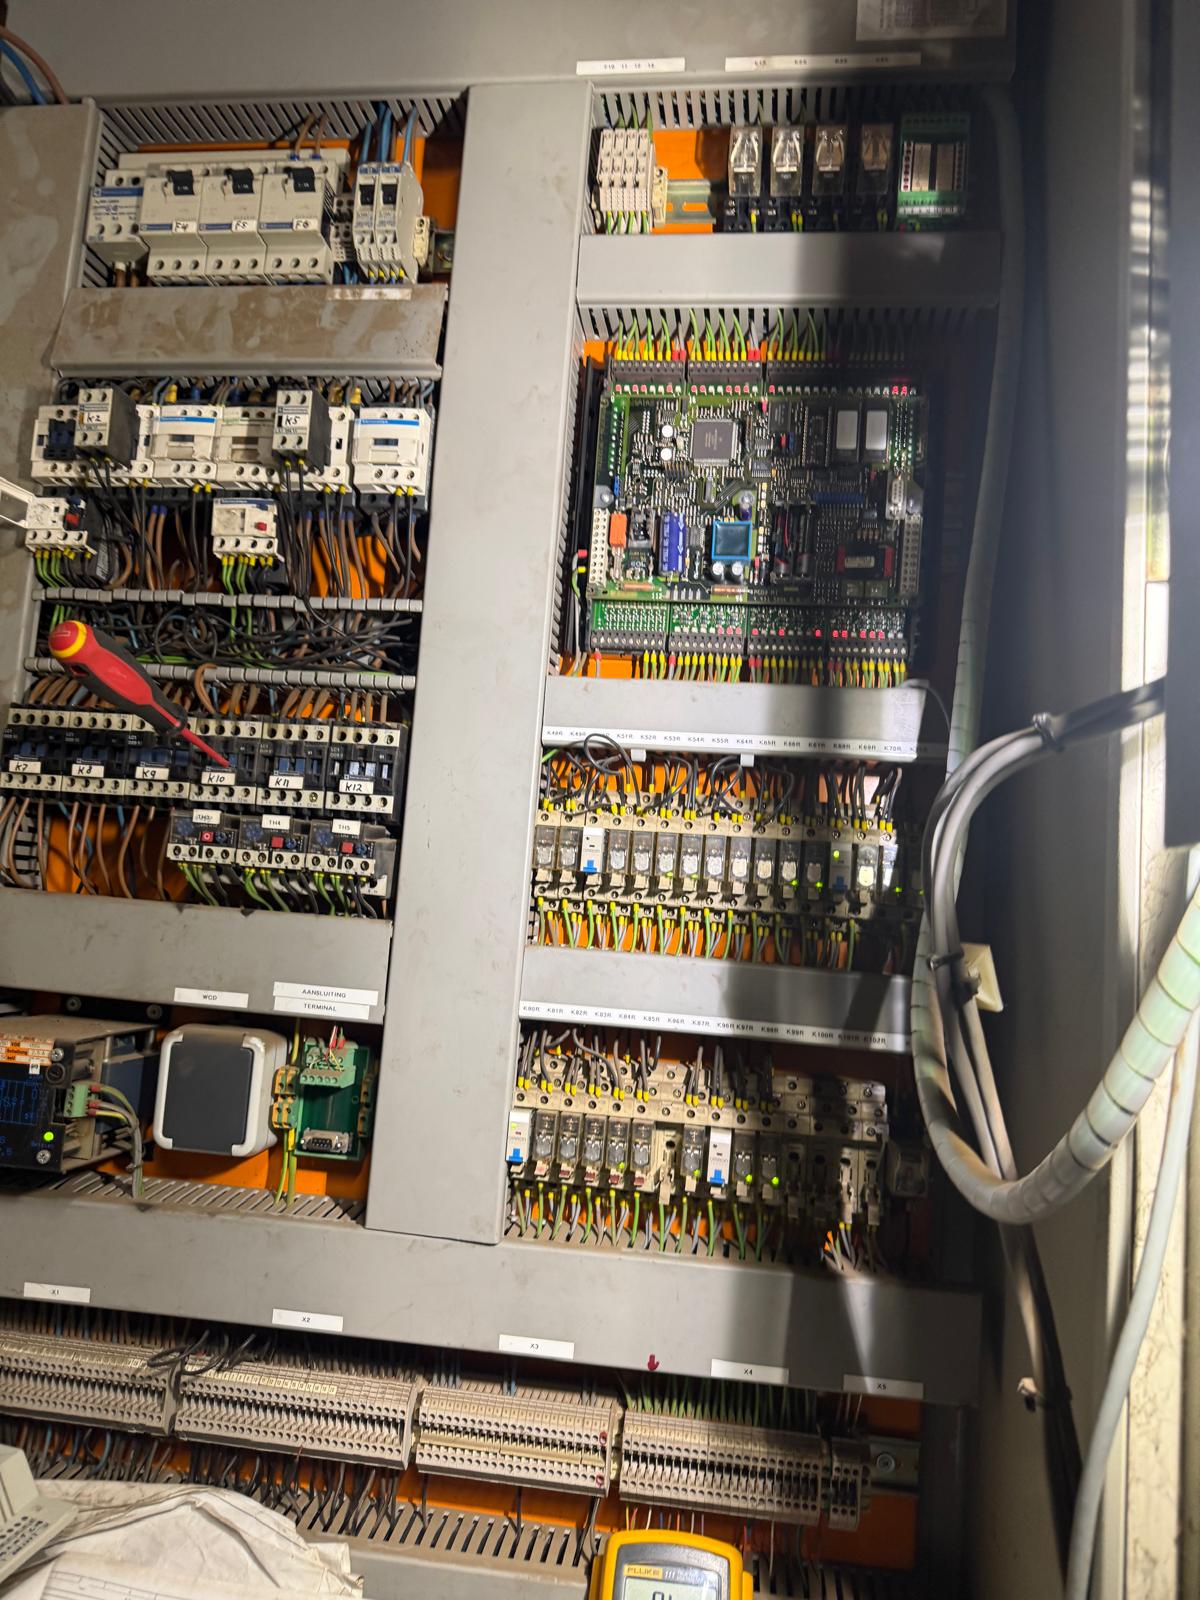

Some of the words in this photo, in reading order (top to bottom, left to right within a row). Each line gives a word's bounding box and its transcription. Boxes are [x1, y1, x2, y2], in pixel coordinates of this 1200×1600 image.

[86, 412, 102, 423] K2
[15, 762, 28, 771] K7
[78, 764, 92, 775] K8
[142, 767, 156, 779] K9
[208, 772, 225, 783] K10
[274, 777, 290, 787] K11
[345, 781, 362, 792] K12
[302, 988, 347, 999] AANSLUITING
[304, 1003, 337, 1012] TERMINAL
[627, 1566, 660, 1577] FLUKE
